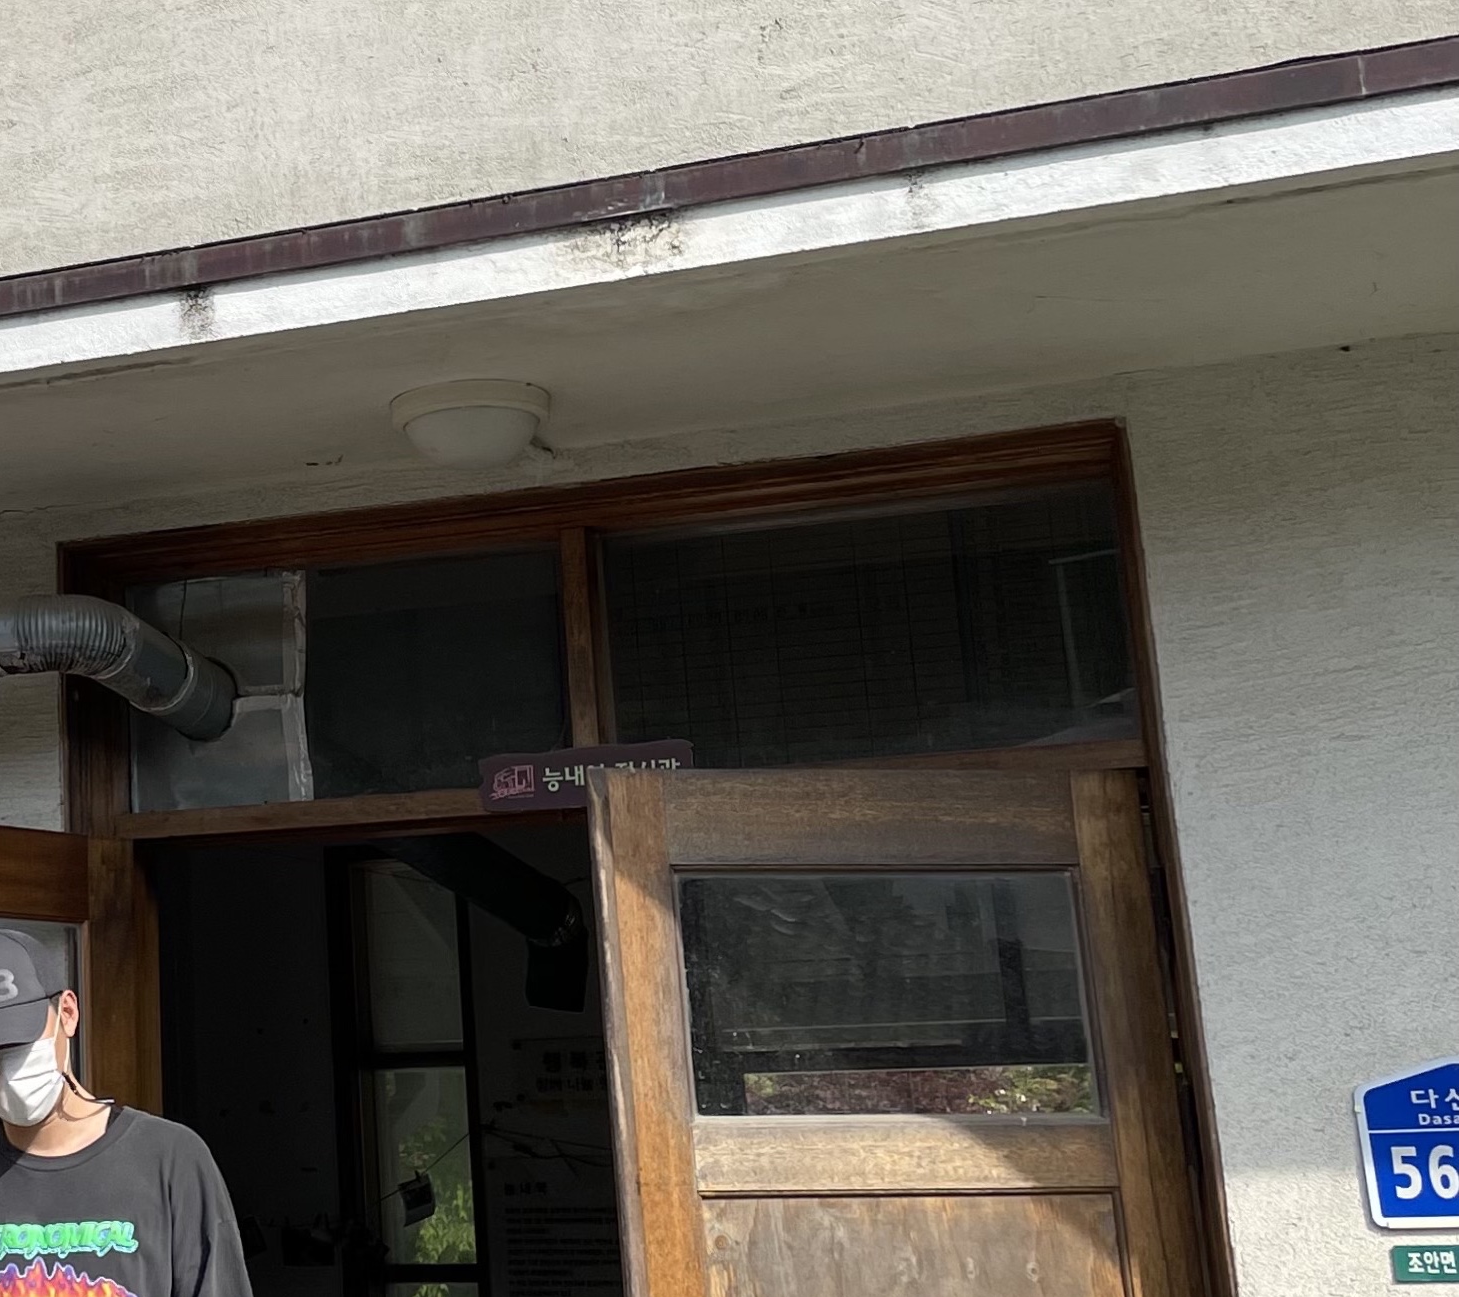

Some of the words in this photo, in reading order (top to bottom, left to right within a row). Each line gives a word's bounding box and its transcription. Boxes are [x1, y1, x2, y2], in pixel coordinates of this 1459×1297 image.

[542, 764, 605, 792] 능내
[1390, 1144, 1459, 1200] 56
[1407, 1250, 1457, 1274] 조안면
